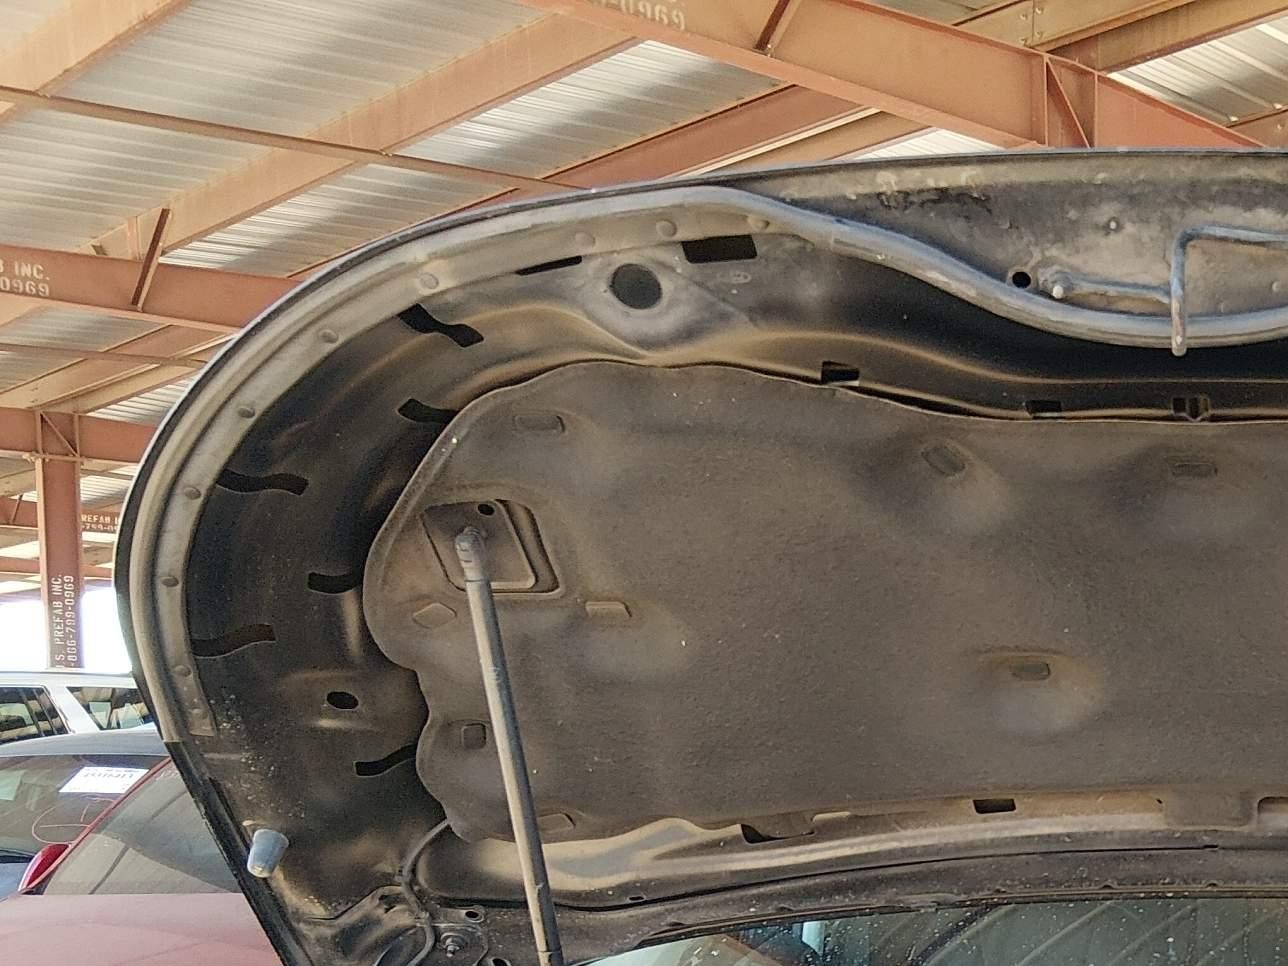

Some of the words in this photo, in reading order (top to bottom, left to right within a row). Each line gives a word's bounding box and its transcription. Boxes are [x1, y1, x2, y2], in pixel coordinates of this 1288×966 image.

[14, 260, 51, 281] INC.
[51, 574, 63, 596] INC.
[53, 601, 65, 645] PREFAB
